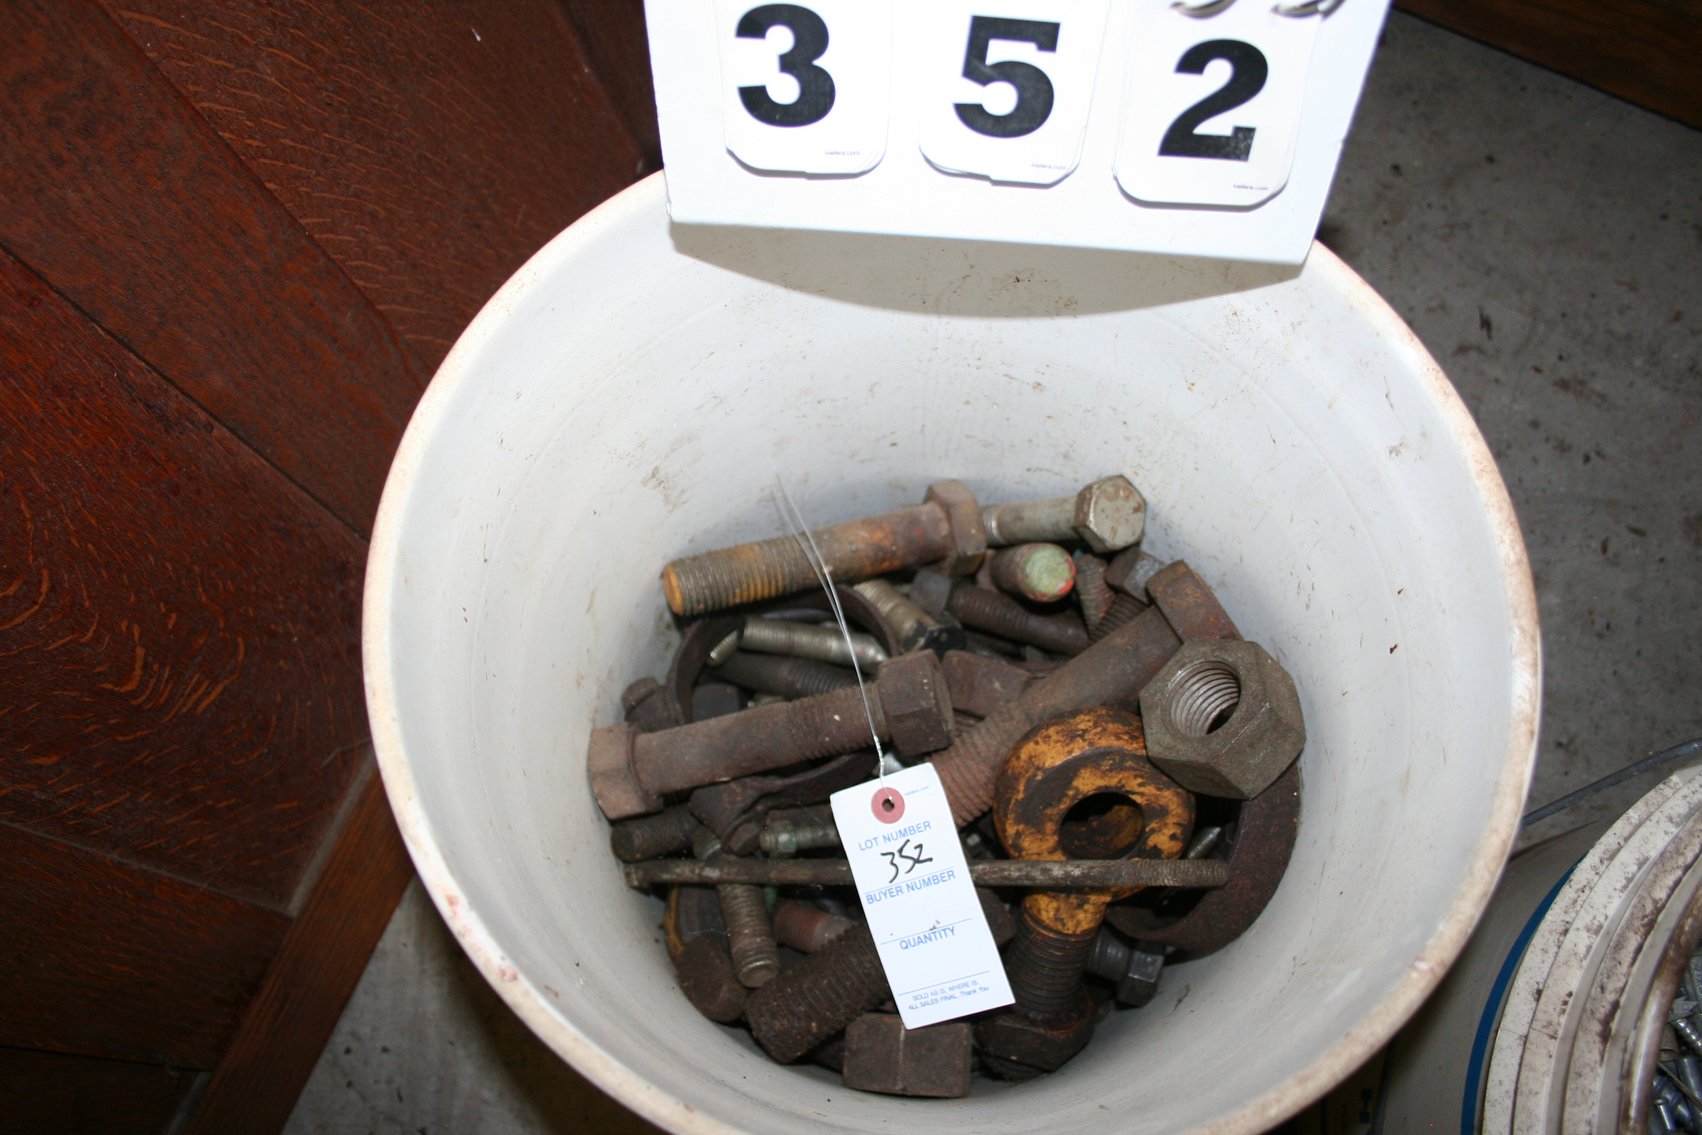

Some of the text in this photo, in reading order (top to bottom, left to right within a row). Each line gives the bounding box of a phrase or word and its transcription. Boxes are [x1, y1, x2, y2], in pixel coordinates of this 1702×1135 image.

[735, 3, 1269, 163] 3 5 2
[858, 820, 931, 851] LOT NUMBER
[880, 839, 933, 883] 352
[866, 870, 956, 904] BUYER NUMBER
[899, 926, 955, 950] QUANTITY
